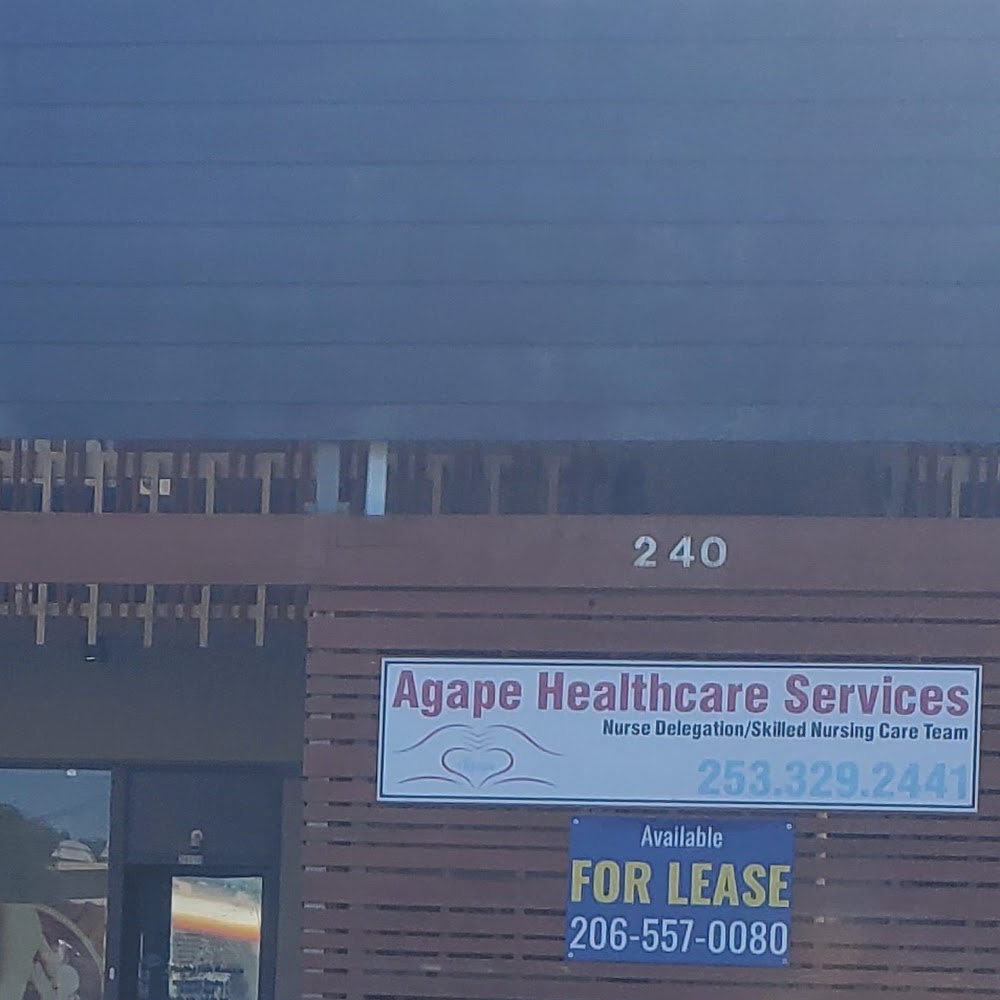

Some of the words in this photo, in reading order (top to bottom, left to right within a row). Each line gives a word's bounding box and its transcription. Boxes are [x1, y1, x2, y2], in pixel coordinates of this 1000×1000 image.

[633, 535, 727, 568] 240
[391, 669, 523, 719] Agape
[537, 671, 770, 714] Healthcare
[784, 673, 970, 717] Services
[602, 719, 651, 736] Nurse
[655, 720, 806, 740] Delegation/Skilled
[810, 722, 875, 742] Nursing
[879, 723, 919, 740] Care
[923, 723, 969, 741] Team
[697, 757, 969, 800] 253.329.2441
[640, 824, 724, 849] Available
[570, 859, 652, 905] FOR
[667, 861, 792, 908] LEASE
[569, 916, 789, 956] 206-557-0080
